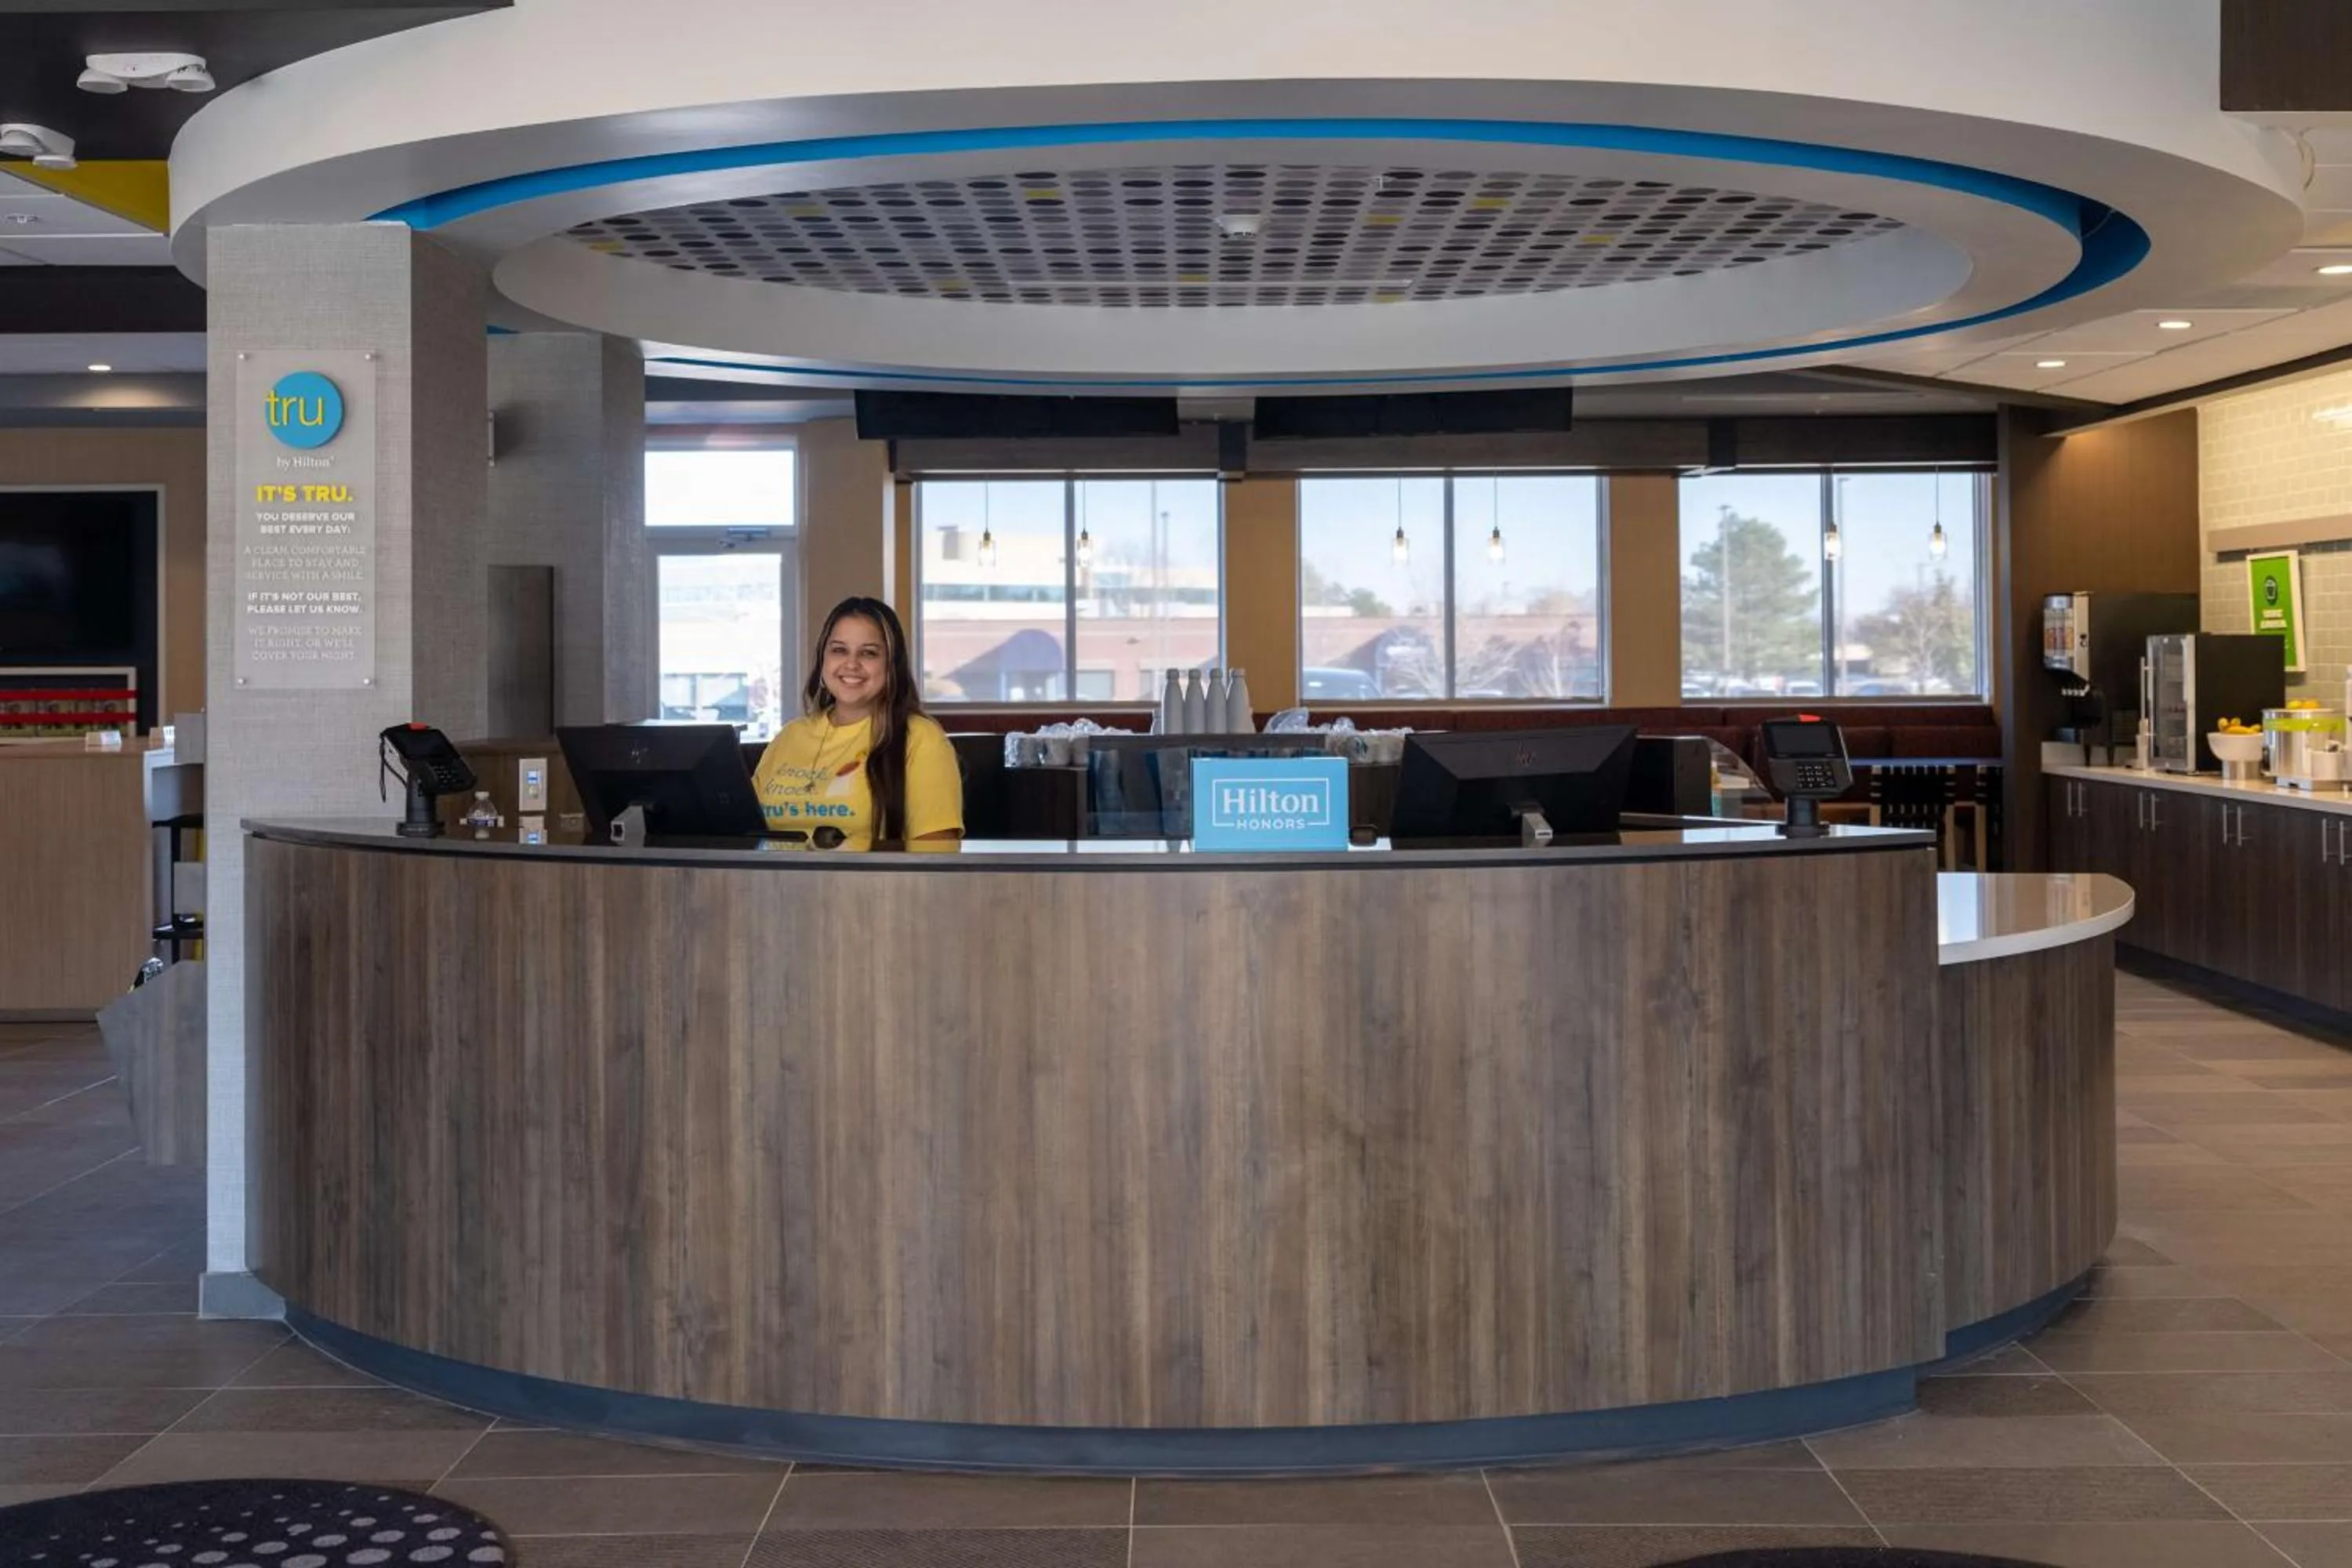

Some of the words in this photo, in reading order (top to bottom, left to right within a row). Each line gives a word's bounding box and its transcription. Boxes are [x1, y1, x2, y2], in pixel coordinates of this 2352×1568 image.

[264, 390, 324, 426] tru
[277, 456, 290, 470] by
[292, 456, 329, 467] Hilton
[257, 485, 296, 502] IT'S
[302, 485, 353, 502] TRU.
[256, 512, 278, 521] YOU
[281, 512, 328, 521] DESERVE
[331, 512, 354, 521] OUR
[260, 524, 285, 534] BEST
[289, 524, 321, 534] EVERY
[248, 593, 257, 601] IF
[281, 593, 303, 601] NOT
[307, 593, 329, 601] OUR
[247, 605, 285, 614] PLEASE
[289, 605, 307, 614] LET
[309, 605, 324, 614] US
[1223, 788, 1320, 814] Hilton
[761, 800, 799, 817] ru's
[805, 800, 855, 816] here.
[1236, 818, 1306, 829] HONORS
